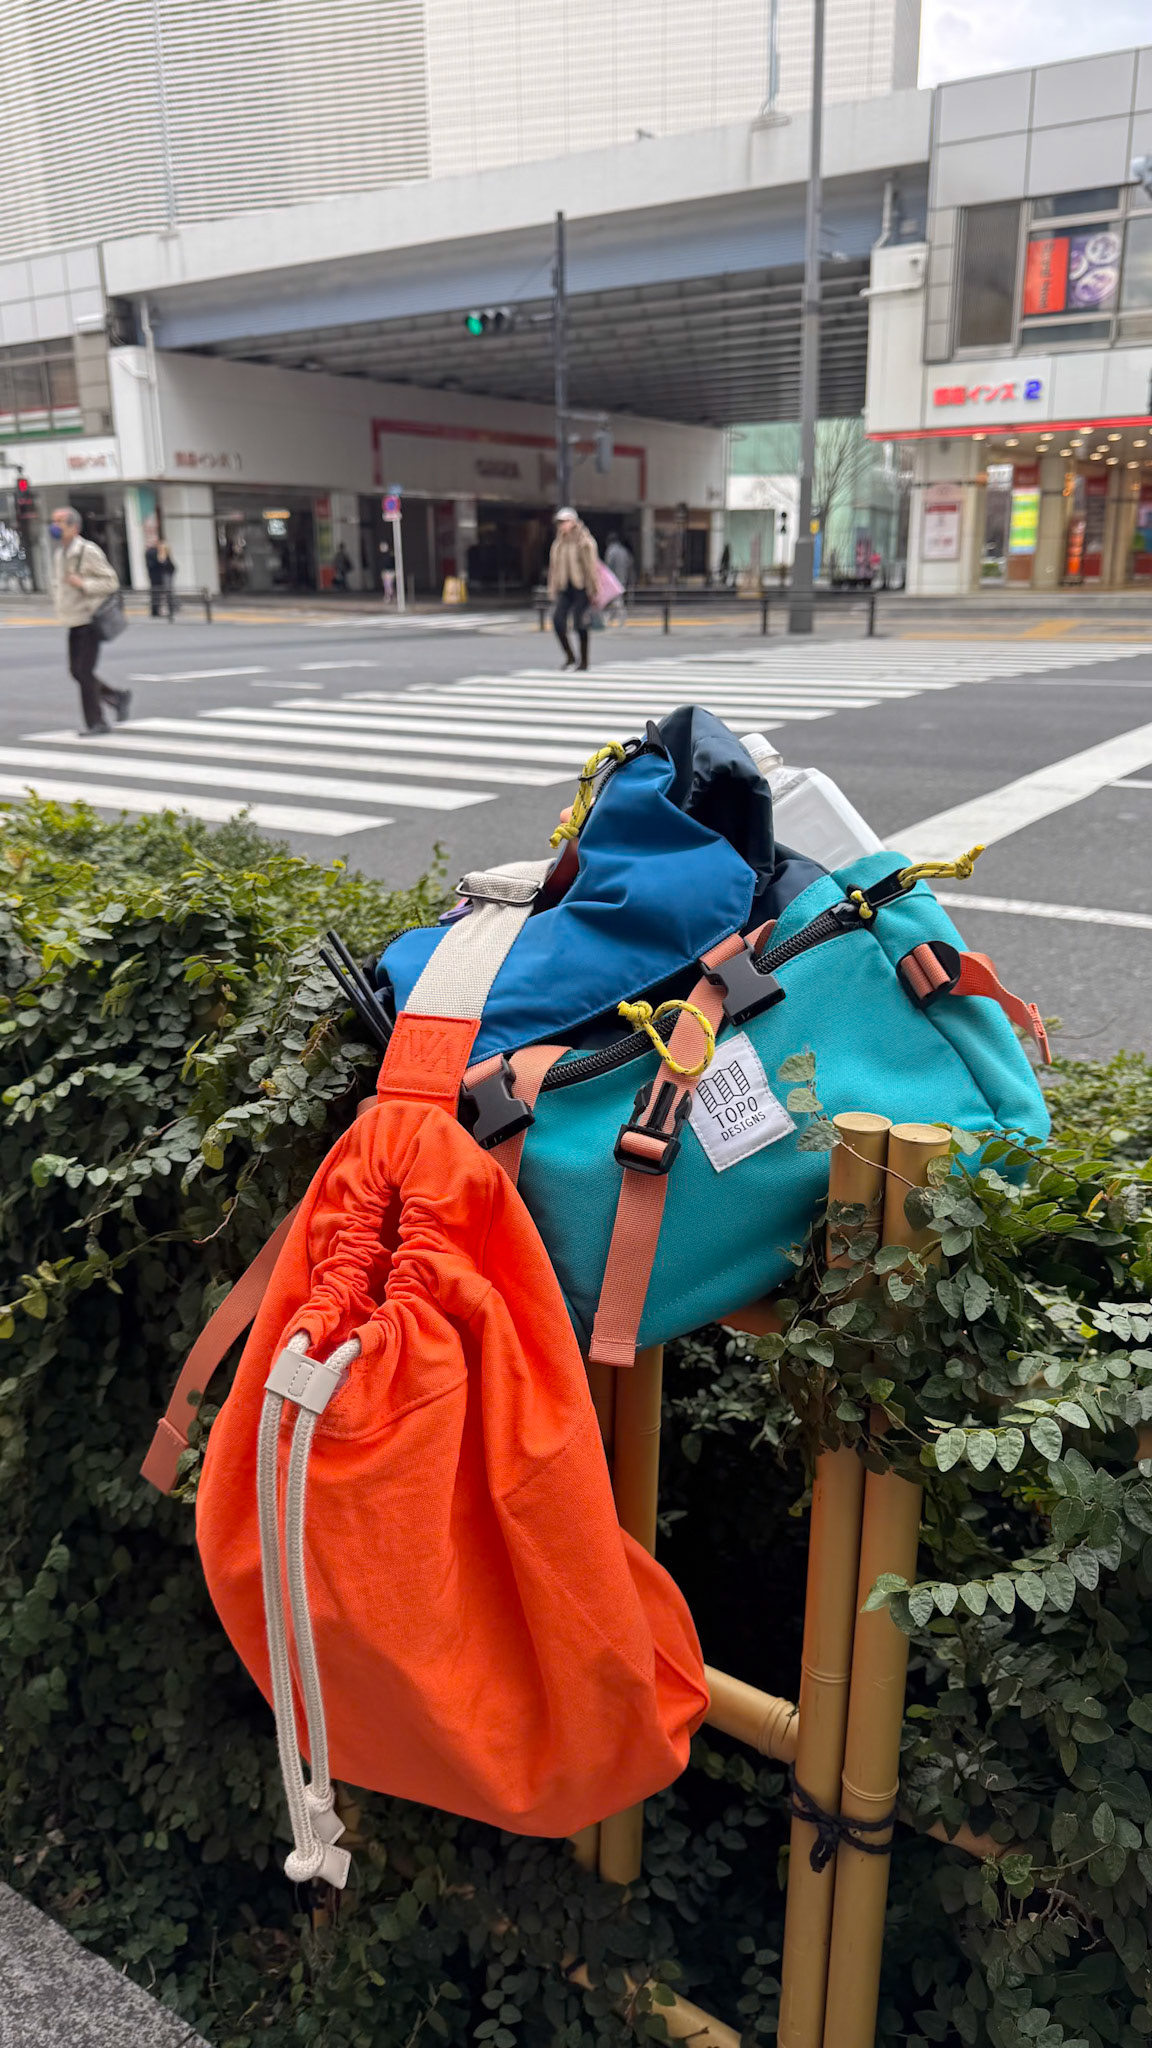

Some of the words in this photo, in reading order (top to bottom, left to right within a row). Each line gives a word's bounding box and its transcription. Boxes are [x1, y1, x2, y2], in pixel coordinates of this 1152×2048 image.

[1024, 379, 1042, 401] 2
[712, 1096, 759, 1129] TOPO
[721, 1112, 766, 1142] DESIGNS
